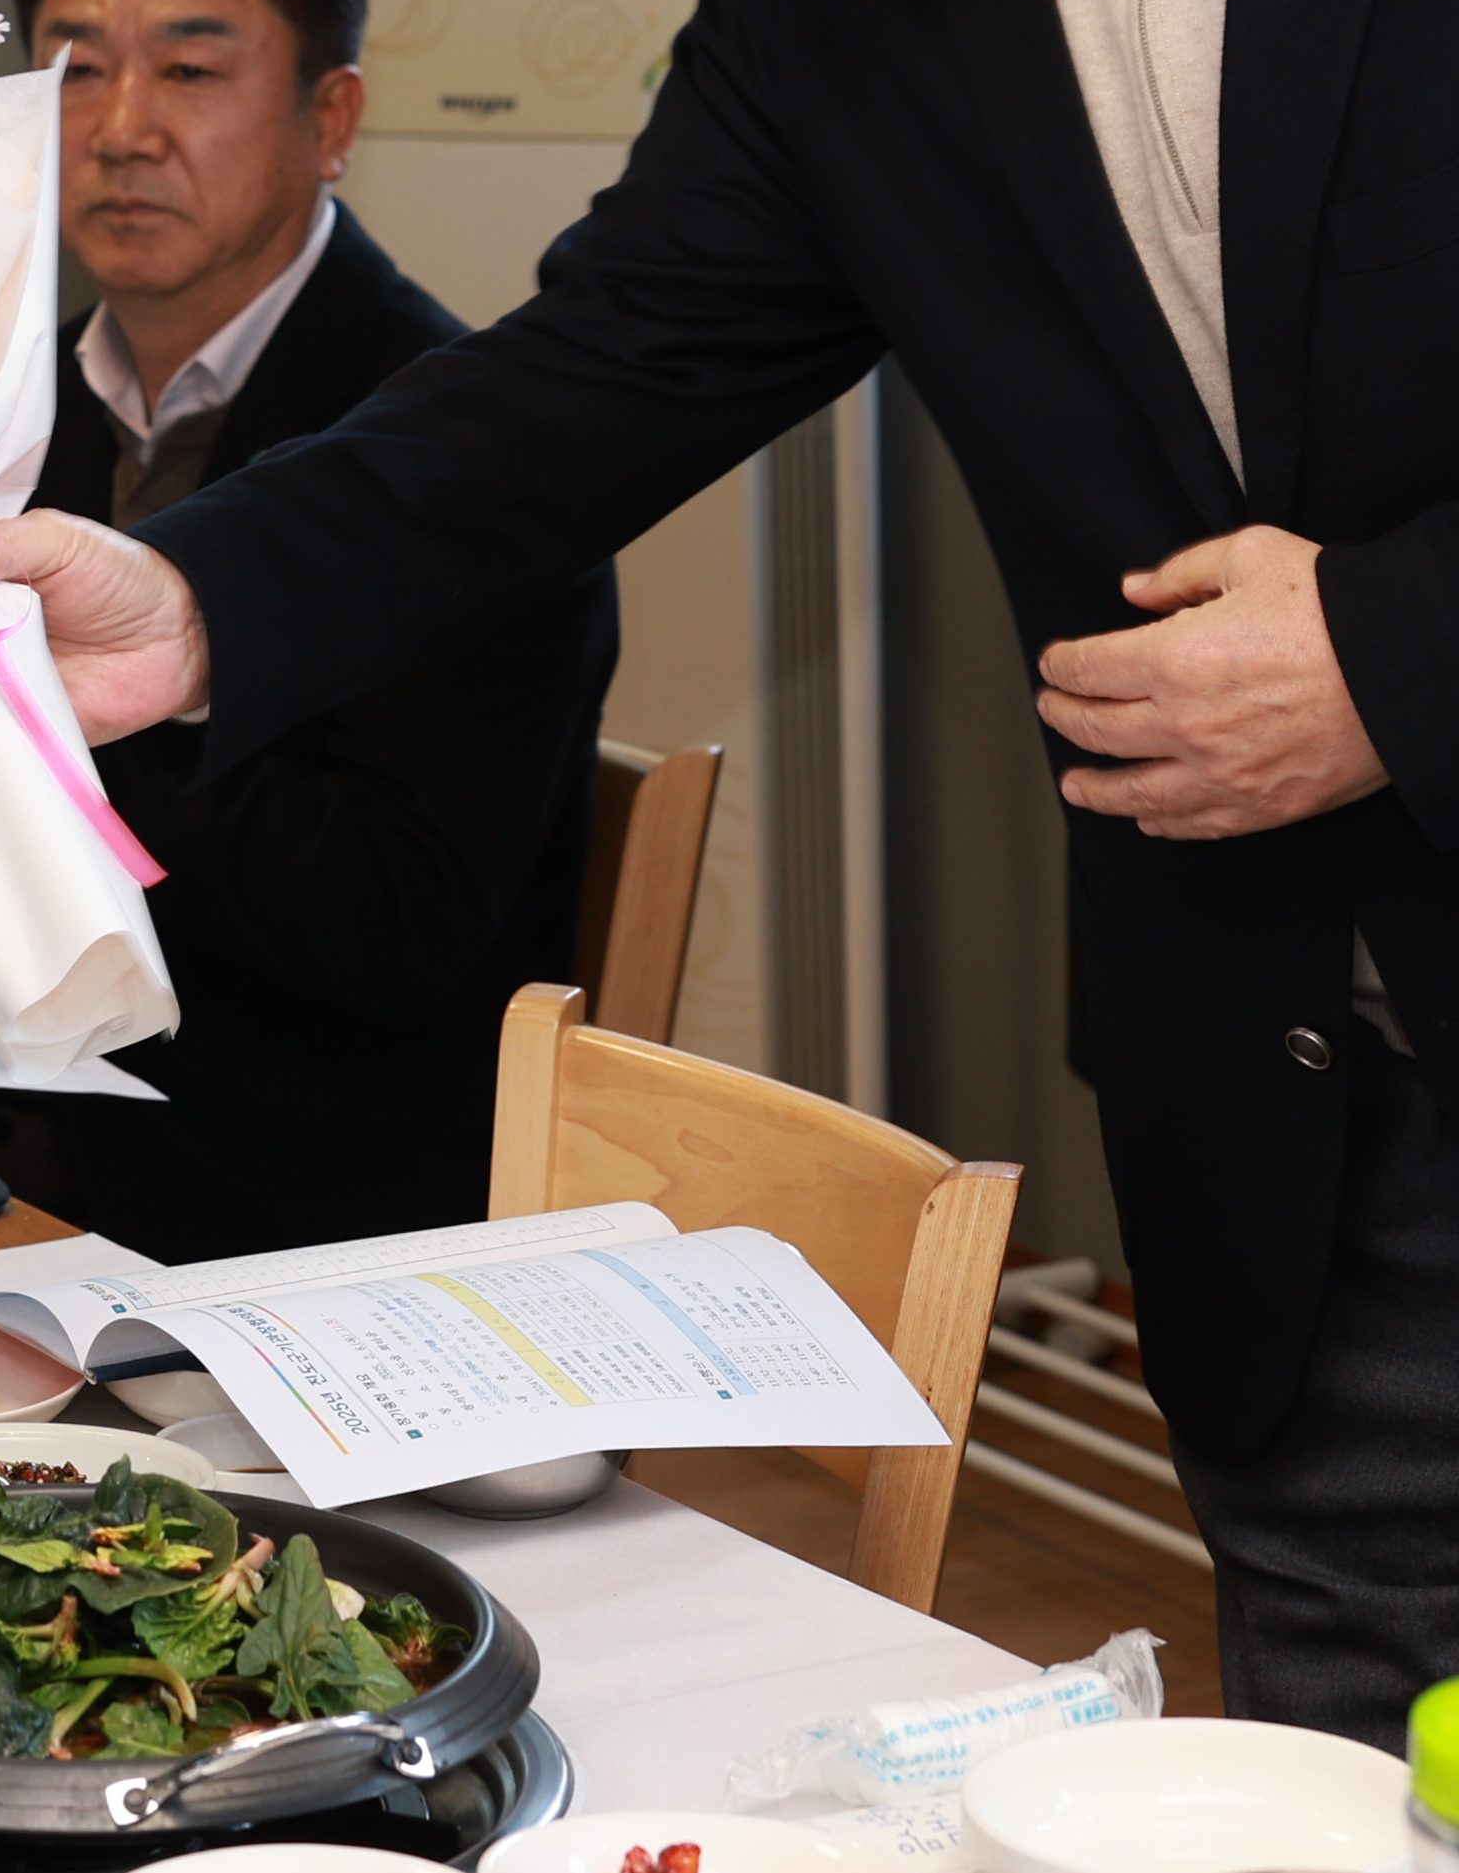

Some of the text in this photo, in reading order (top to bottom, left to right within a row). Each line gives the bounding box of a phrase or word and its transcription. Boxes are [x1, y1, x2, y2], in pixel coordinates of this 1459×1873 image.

[684, 1353, 720, 1385] 진행순서
[321, 1392, 368, 1433] 2025년
[356, 1373, 410, 1425] 정기총회 개요
